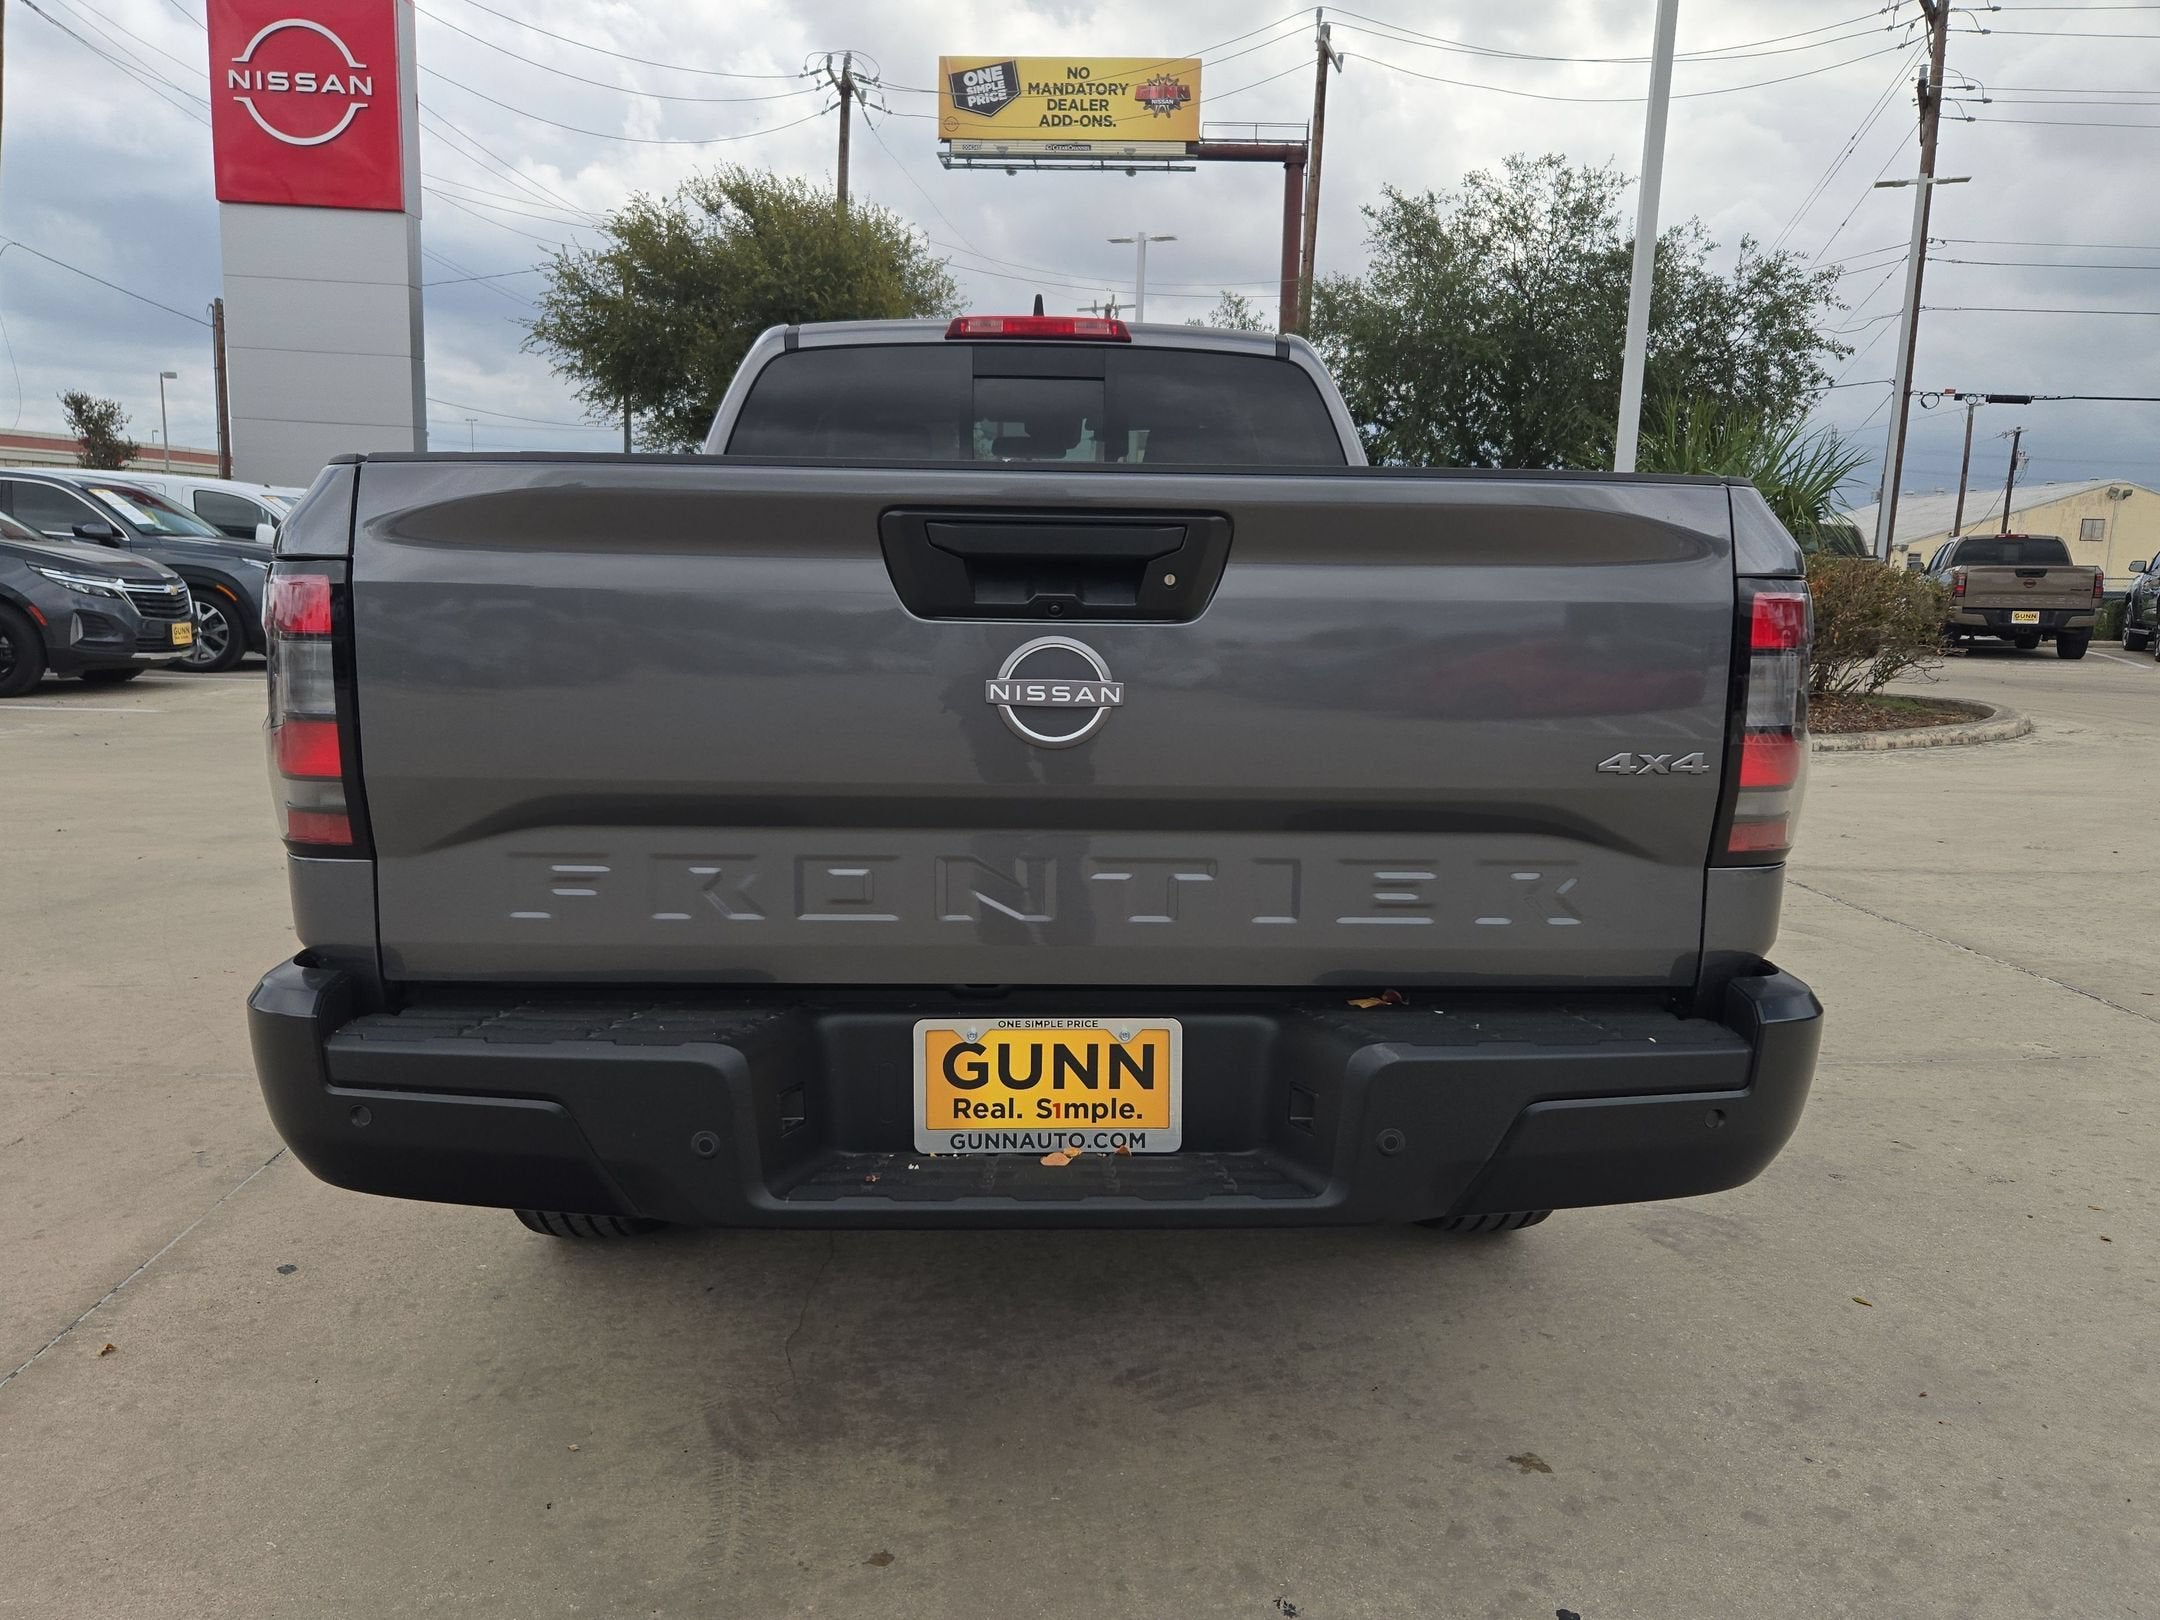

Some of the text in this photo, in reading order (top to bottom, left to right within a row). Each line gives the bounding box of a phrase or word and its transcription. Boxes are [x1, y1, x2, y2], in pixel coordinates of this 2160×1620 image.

[963, 65, 1004, 87] ONE
[1067, 66, 1090, 79] NO
[228, 69, 373, 96] NISSAN
[966, 80, 1006, 95] SIMPLE
[1028, 82, 1129, 96] MANDATORY
[1135, 84, 1191, 102] GUNN
[1047, 98, 1110, 112] DEALER
[1039, 114, 1117, 128] ADD-ONS.
[989, 683, 1120, 703] NISSAN
[507, 852, 1582, 926] FRONTIER
[998, 1020, 1099, 1028] ONE SIMPLE PRICE
[942, 1041, 1155, 1090] GUNN
[953, 1097, 1023, 1119] Real.
[950, 1132, 1146, 1150] GUNNAUTO.COM
